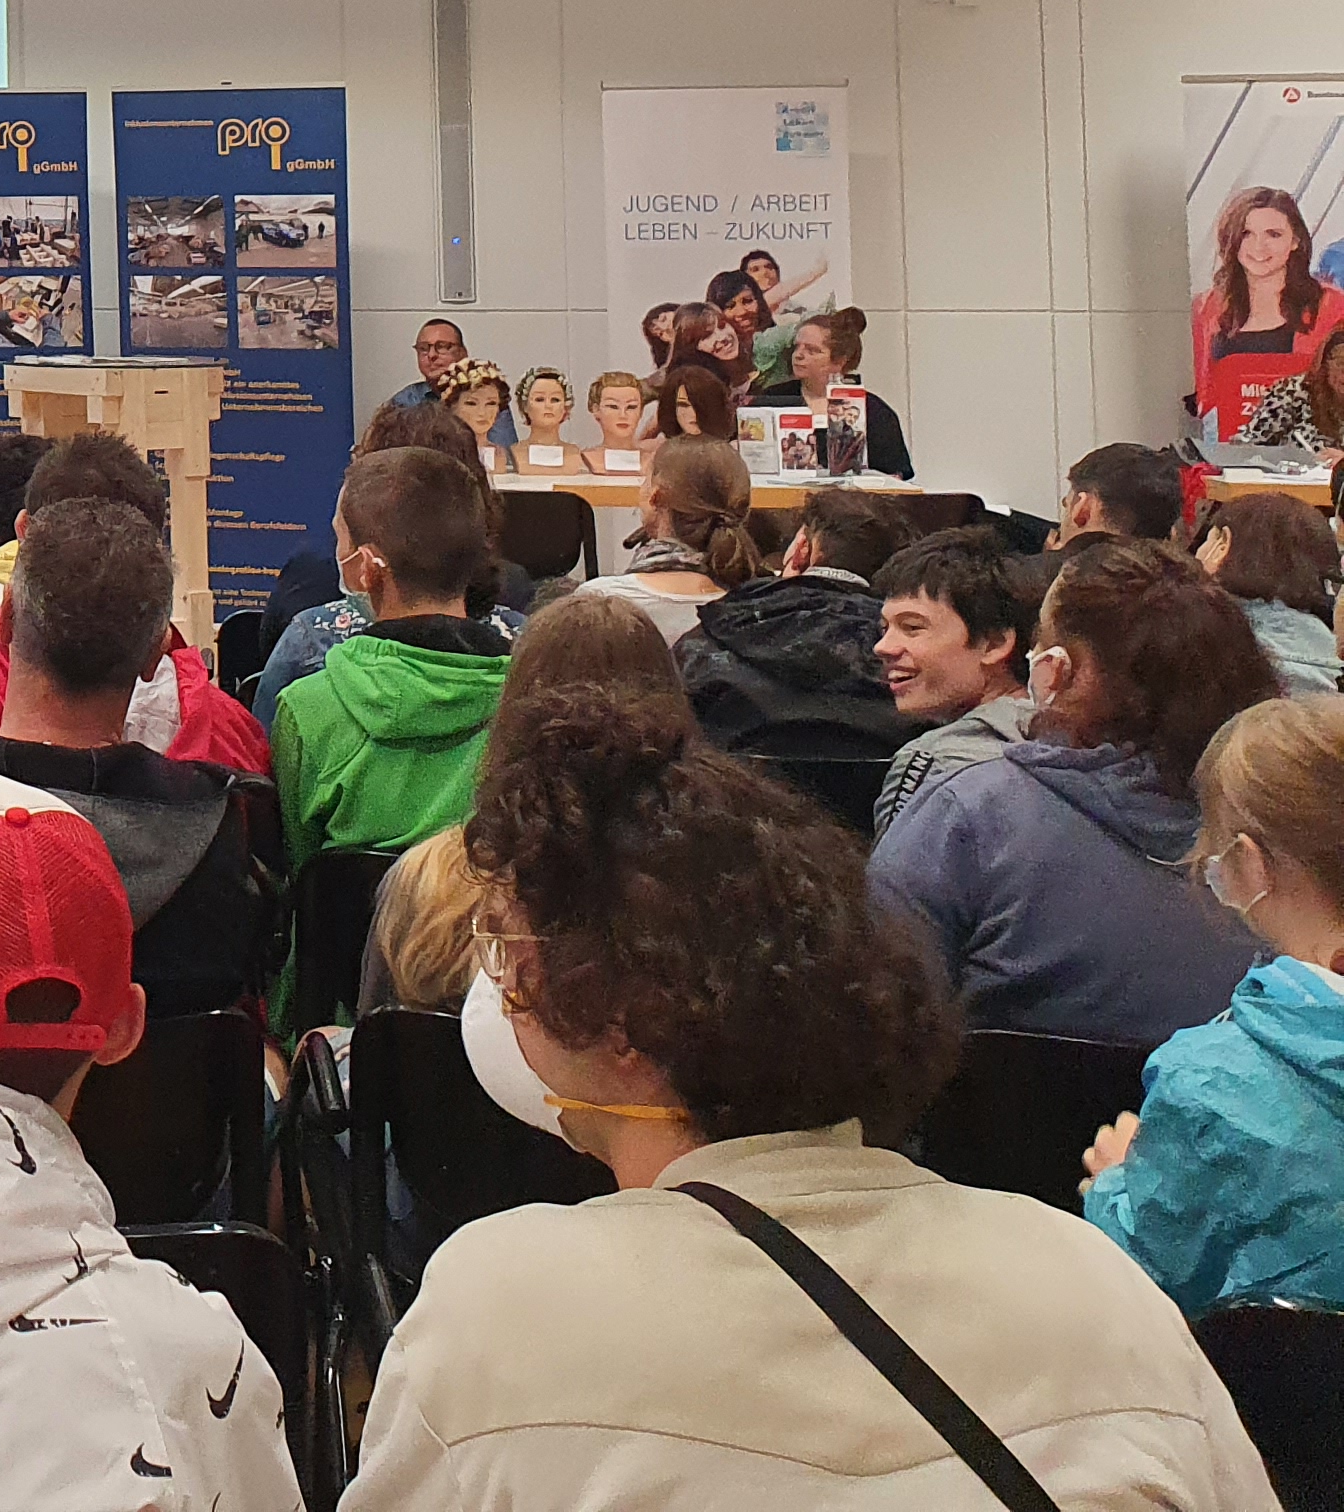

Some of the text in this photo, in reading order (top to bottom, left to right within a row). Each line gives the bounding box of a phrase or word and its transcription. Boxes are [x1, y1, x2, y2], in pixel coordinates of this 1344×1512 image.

[33, 161, 78, 173] gGmbH
[286, 158, 335, 172] gGmbH
[623, 194, 718, 213] JUGEND
[750, 194, 831, 212] ARBEIT
[624, 222, 698, 241] LEBEN
[724, 221, 832, 240] ZUKUNFT
